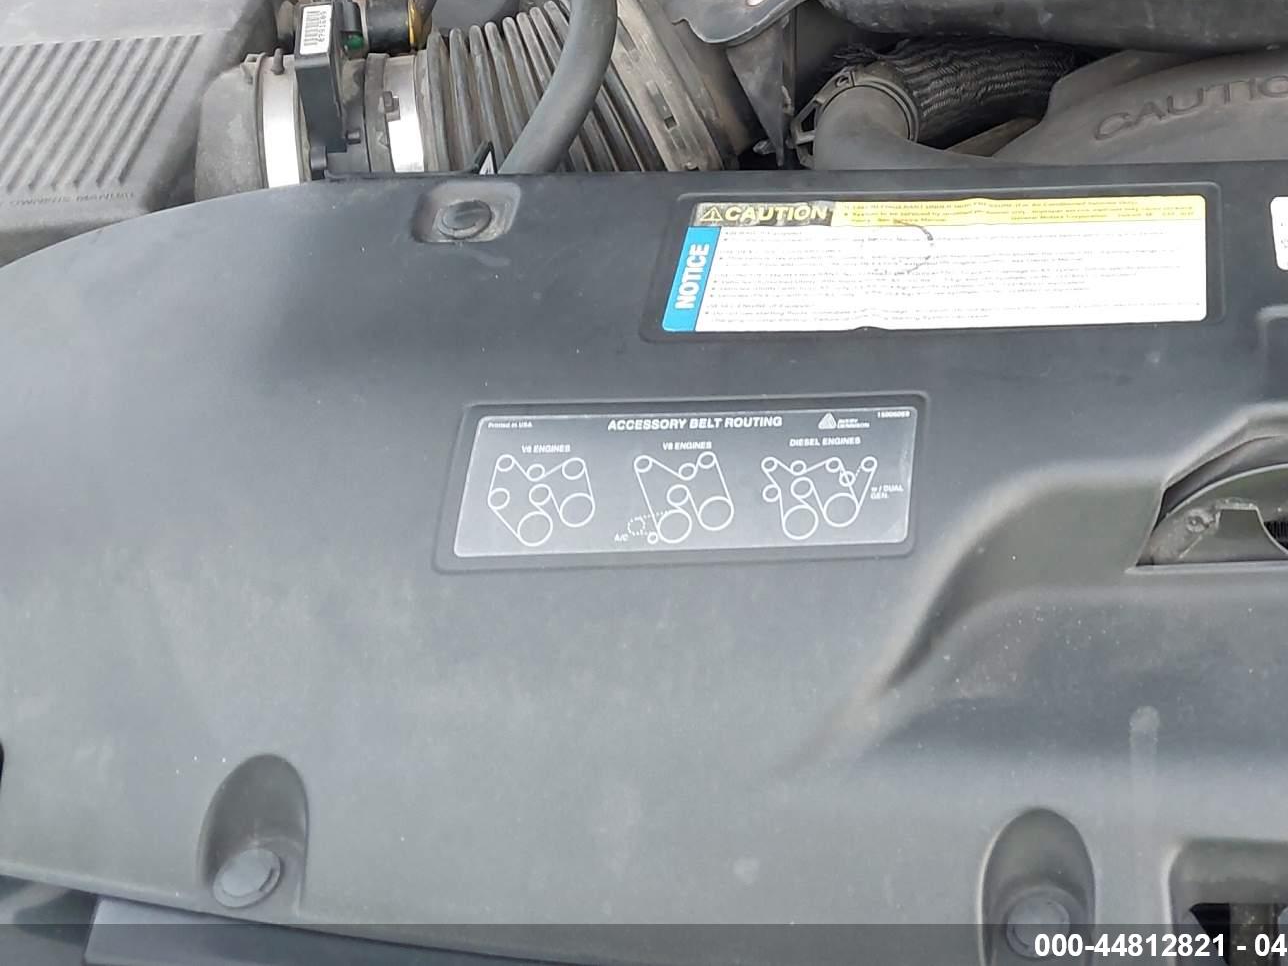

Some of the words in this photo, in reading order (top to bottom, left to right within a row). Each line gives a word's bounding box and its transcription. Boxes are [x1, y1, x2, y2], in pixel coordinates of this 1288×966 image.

[724, 204, 829, 222] CAUTION
[674, 243, 710, 309] NOTICE
[607, 418, 687, 431] ACCESSORY
[689, 417, 723, 429] BELT
[724, 416, 783, 428] ROUTING
[533, 443, 571, 453] ENGINES
[674, 441, 712, 450] ENGINES
[789, 438, 820, 447] DIESEL
[822, 436, 861, 446] ENGINES
